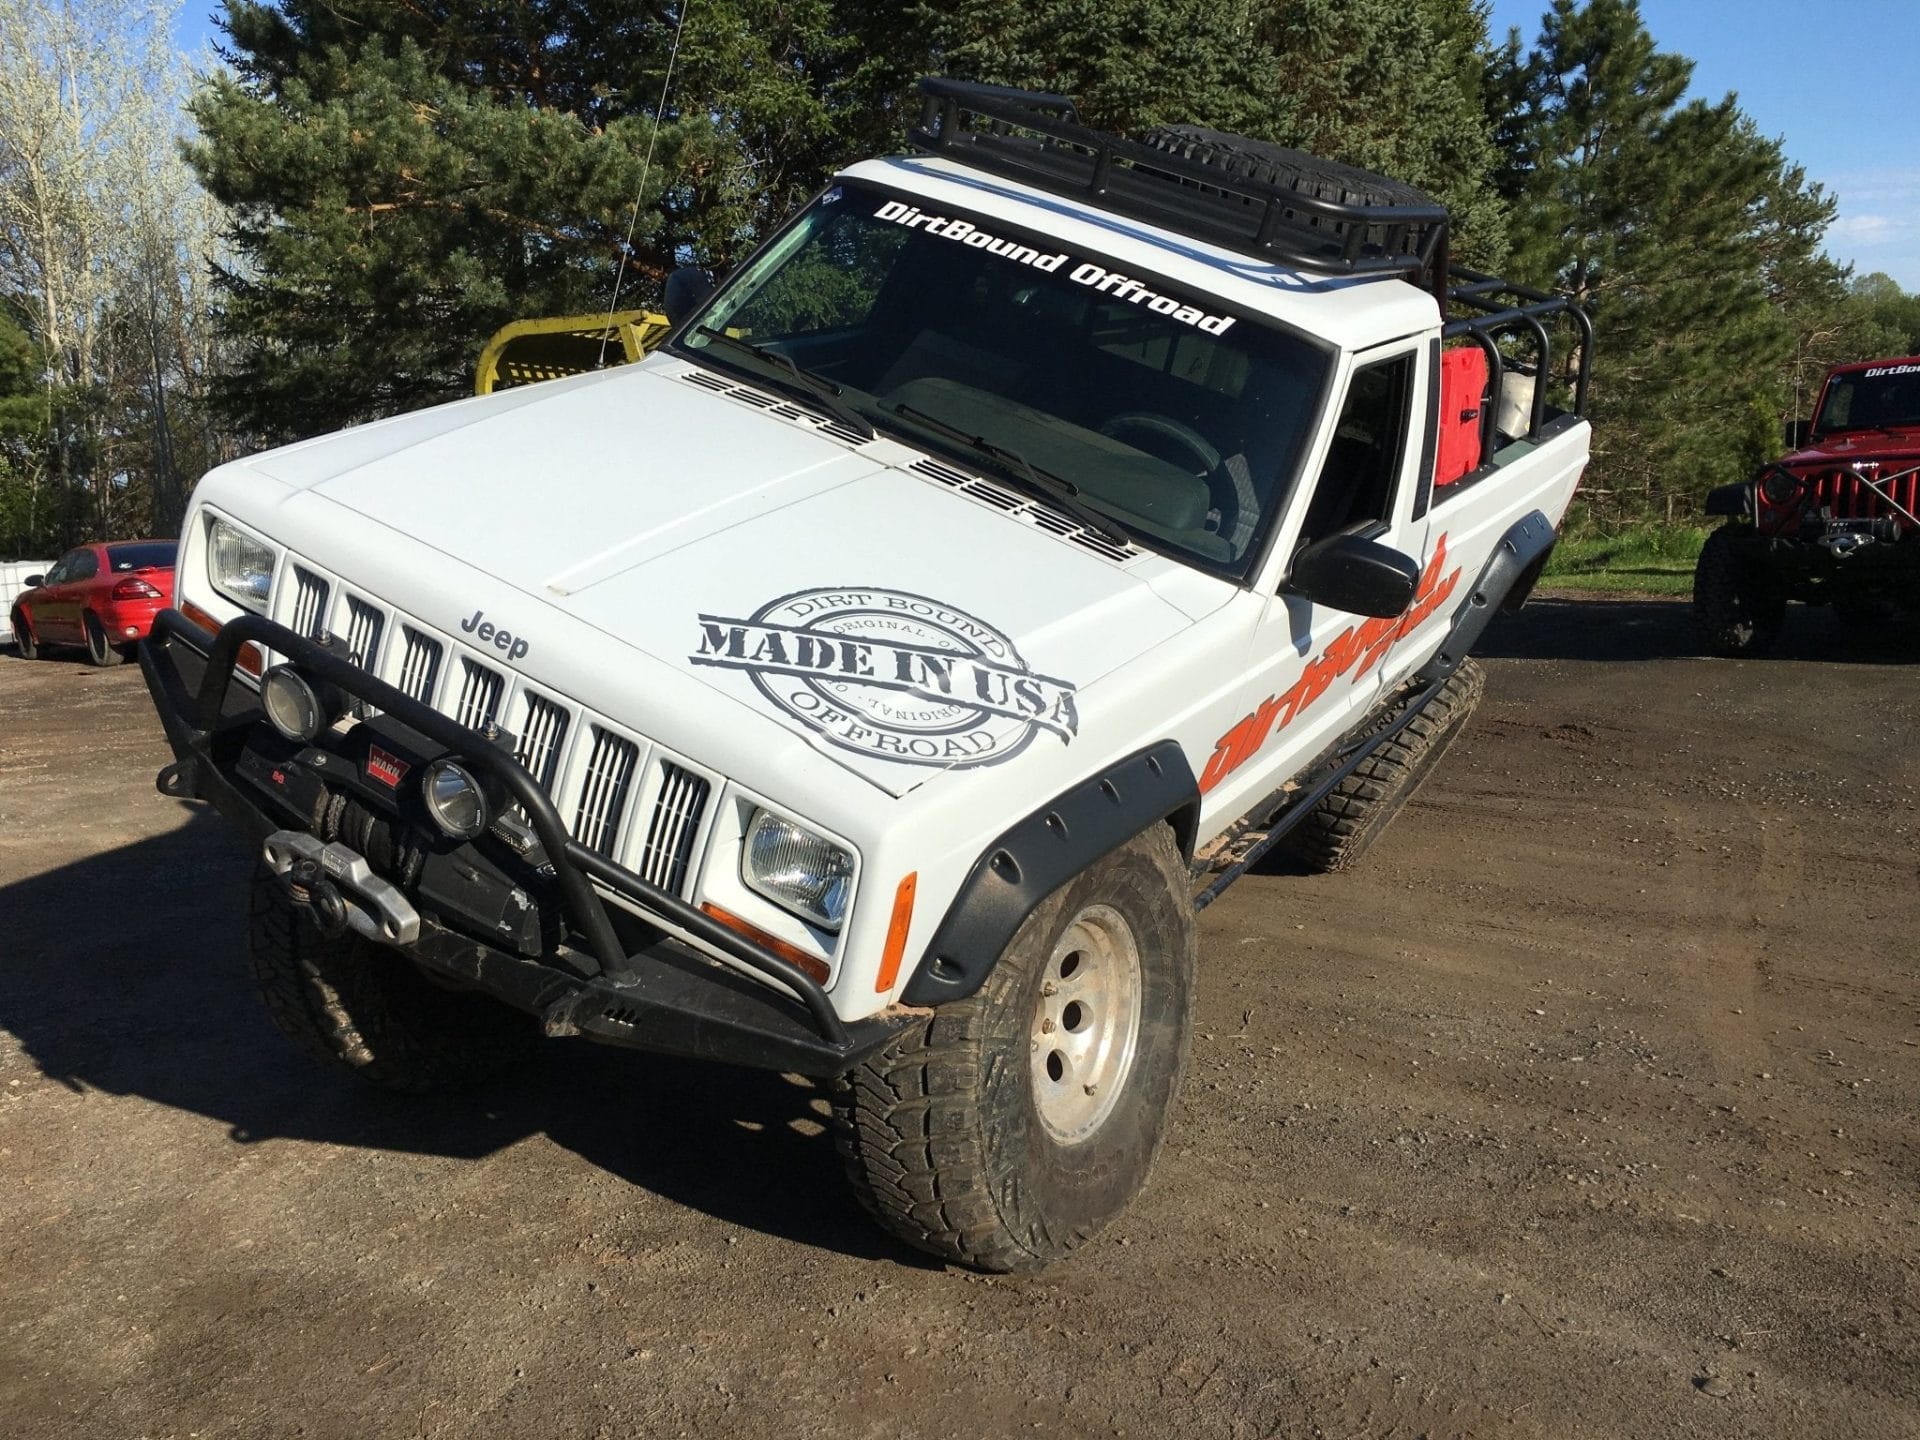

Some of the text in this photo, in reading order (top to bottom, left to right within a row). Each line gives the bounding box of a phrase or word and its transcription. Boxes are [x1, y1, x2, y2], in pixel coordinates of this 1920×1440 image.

[873, 201, 1237, 336] DirtBound Offroad
[461, 610, 529, 661] Jeep
[784, 594, 1005, 658] DIRT BOUND
[833, 619, 925, 637] ORIGINAL
[696, 622, 1079, 737] MADE IN USA
[790, 691, 996, 757] OFFROAD
[372, 755, 400, 780] WARN
